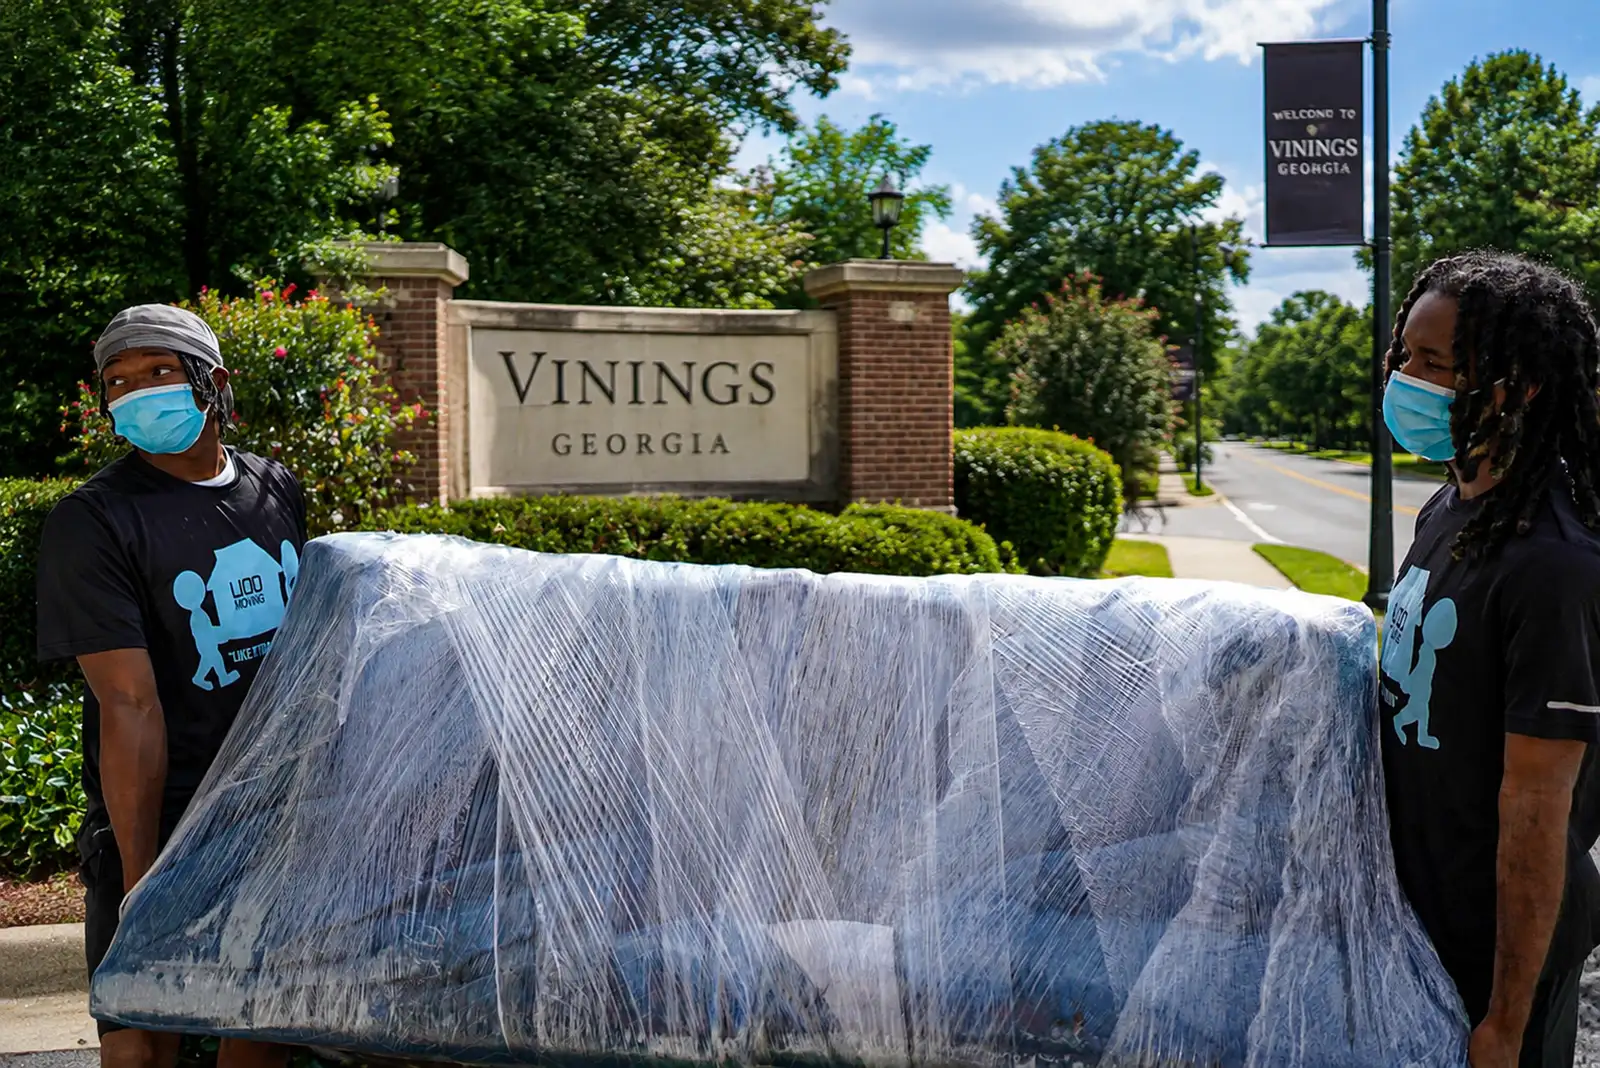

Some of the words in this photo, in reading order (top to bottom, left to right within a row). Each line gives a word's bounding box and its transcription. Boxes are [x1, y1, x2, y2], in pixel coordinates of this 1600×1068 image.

[1339, 108, 1356, 119] TO
[1269, 138, 1358, 158] VININGS
[498, 351, 777, 406] VININGS
[551, 432, 730, 456] GEORGIA
